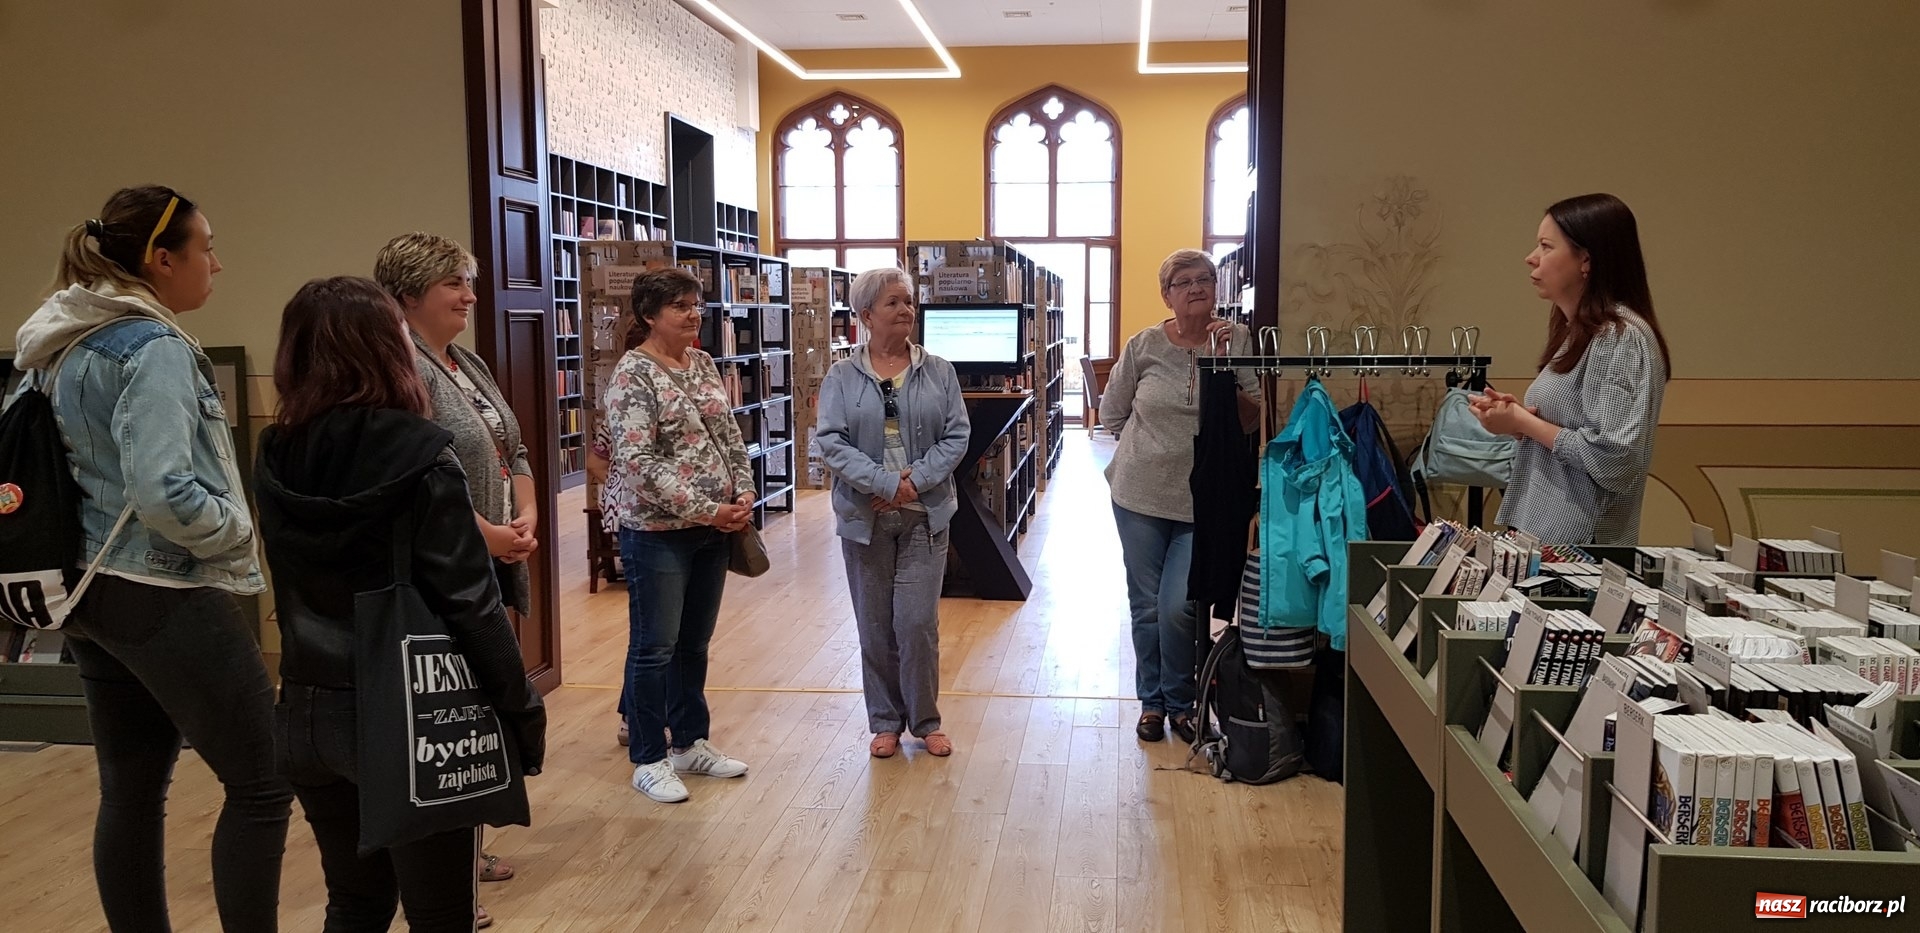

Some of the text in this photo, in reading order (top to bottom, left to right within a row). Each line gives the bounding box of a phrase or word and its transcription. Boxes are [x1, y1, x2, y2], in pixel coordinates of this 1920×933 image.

[1535, 640, 1554, 686] ATAK TYTAN
[1548, 640, 1567, 686] ATAK TYTAN
[1560, 642, 1578, 686] ATAK TYTAN
[1572, 641, 1591, 686] ATAK TYTAN
[1623, 702, 1645, 728] BERSERK
[416, 729, 499, 767] byciem
[438, 762, 498, 791] zajebistą
[1676, 795, 1692, 845] BERSERK
[1696, 797, 1714, 846] BERSER
[1714, 797, 1731, 846] BERSER
[1731, 799, 1749, 847] BERSER
[1789, 801, 1811, 849] BERSER
[1806, 803, 1829, 850] BERSER
[1828, 804, 1850, 850] BERSER
[1848, 801, 1873, 850] BERSER
